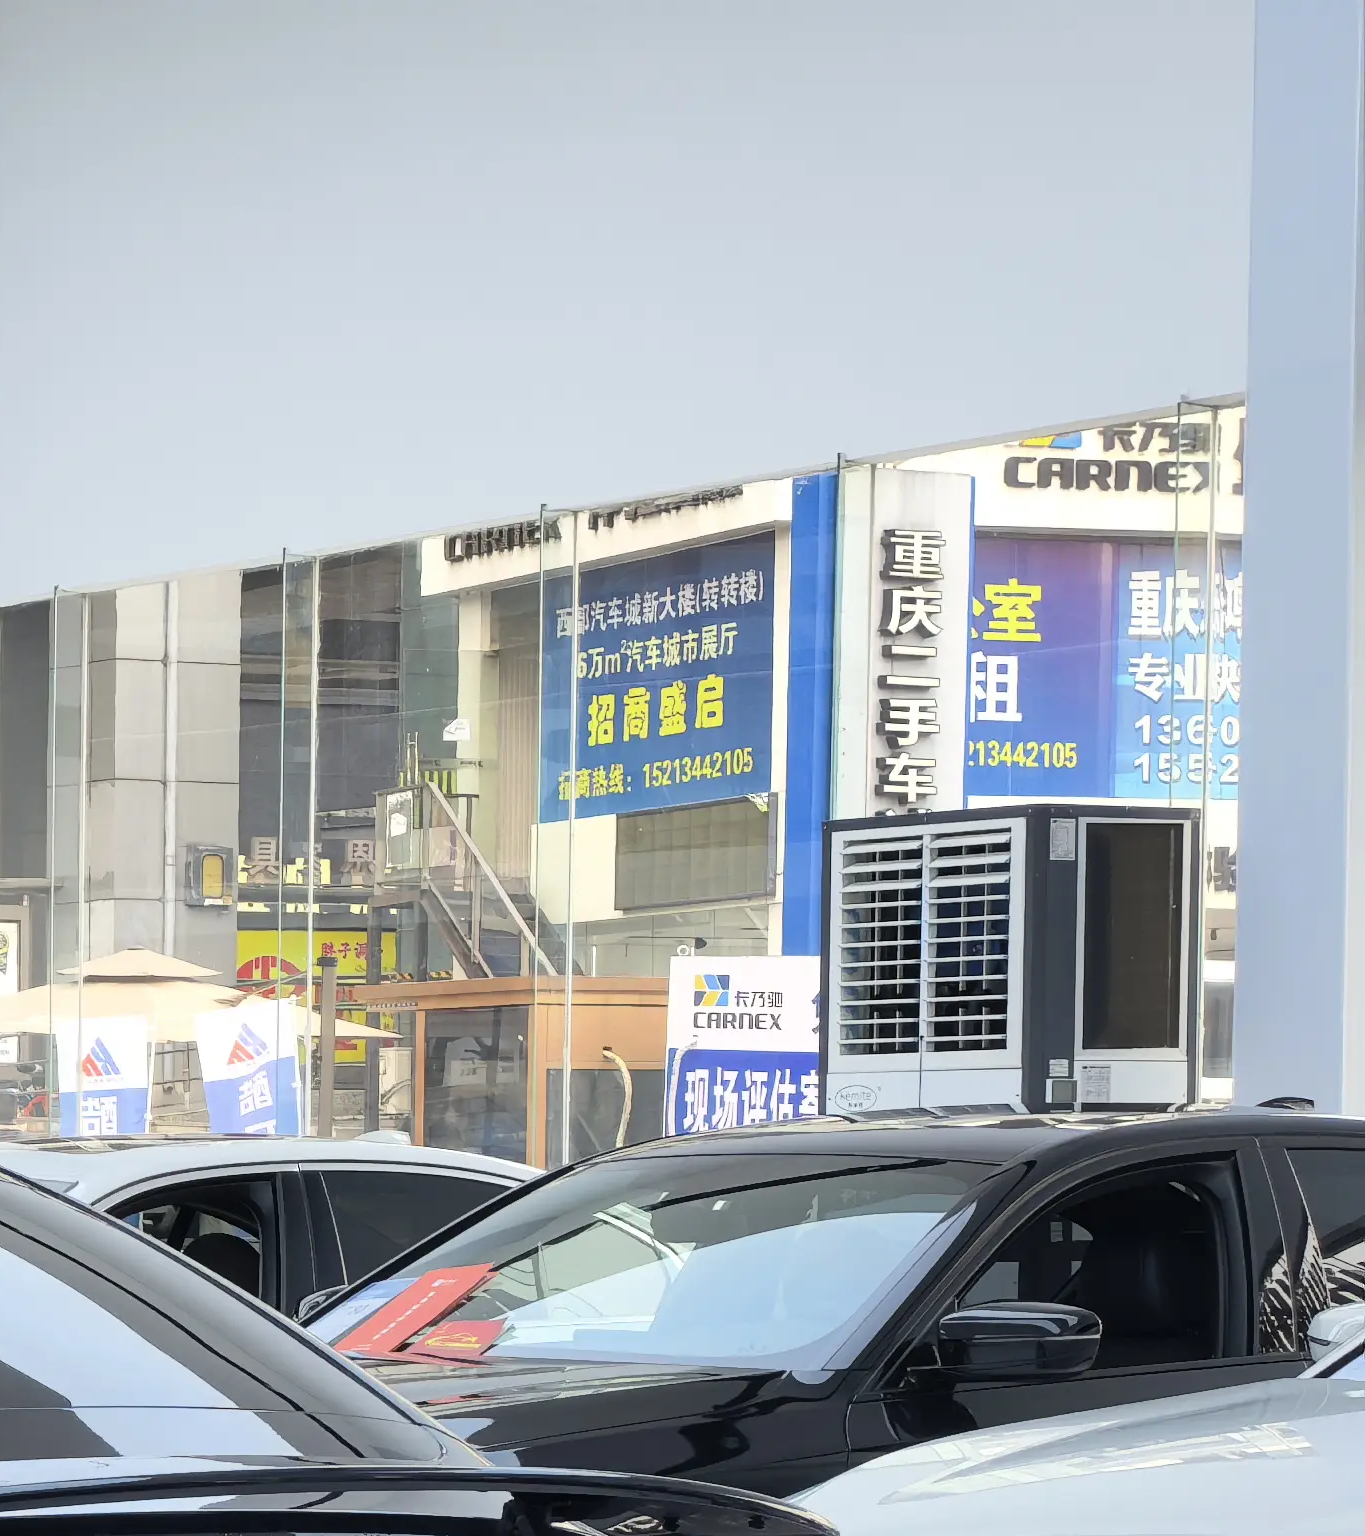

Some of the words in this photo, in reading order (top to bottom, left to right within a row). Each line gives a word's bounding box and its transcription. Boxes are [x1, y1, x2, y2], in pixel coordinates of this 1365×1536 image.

[875, 529, 946, 815] 重庆二手车
[588, 673, 725, 747] 招商盛启
[643, 747, 754, 789] 15213442105
[693, 1012, 782, 1031] CARNEX
